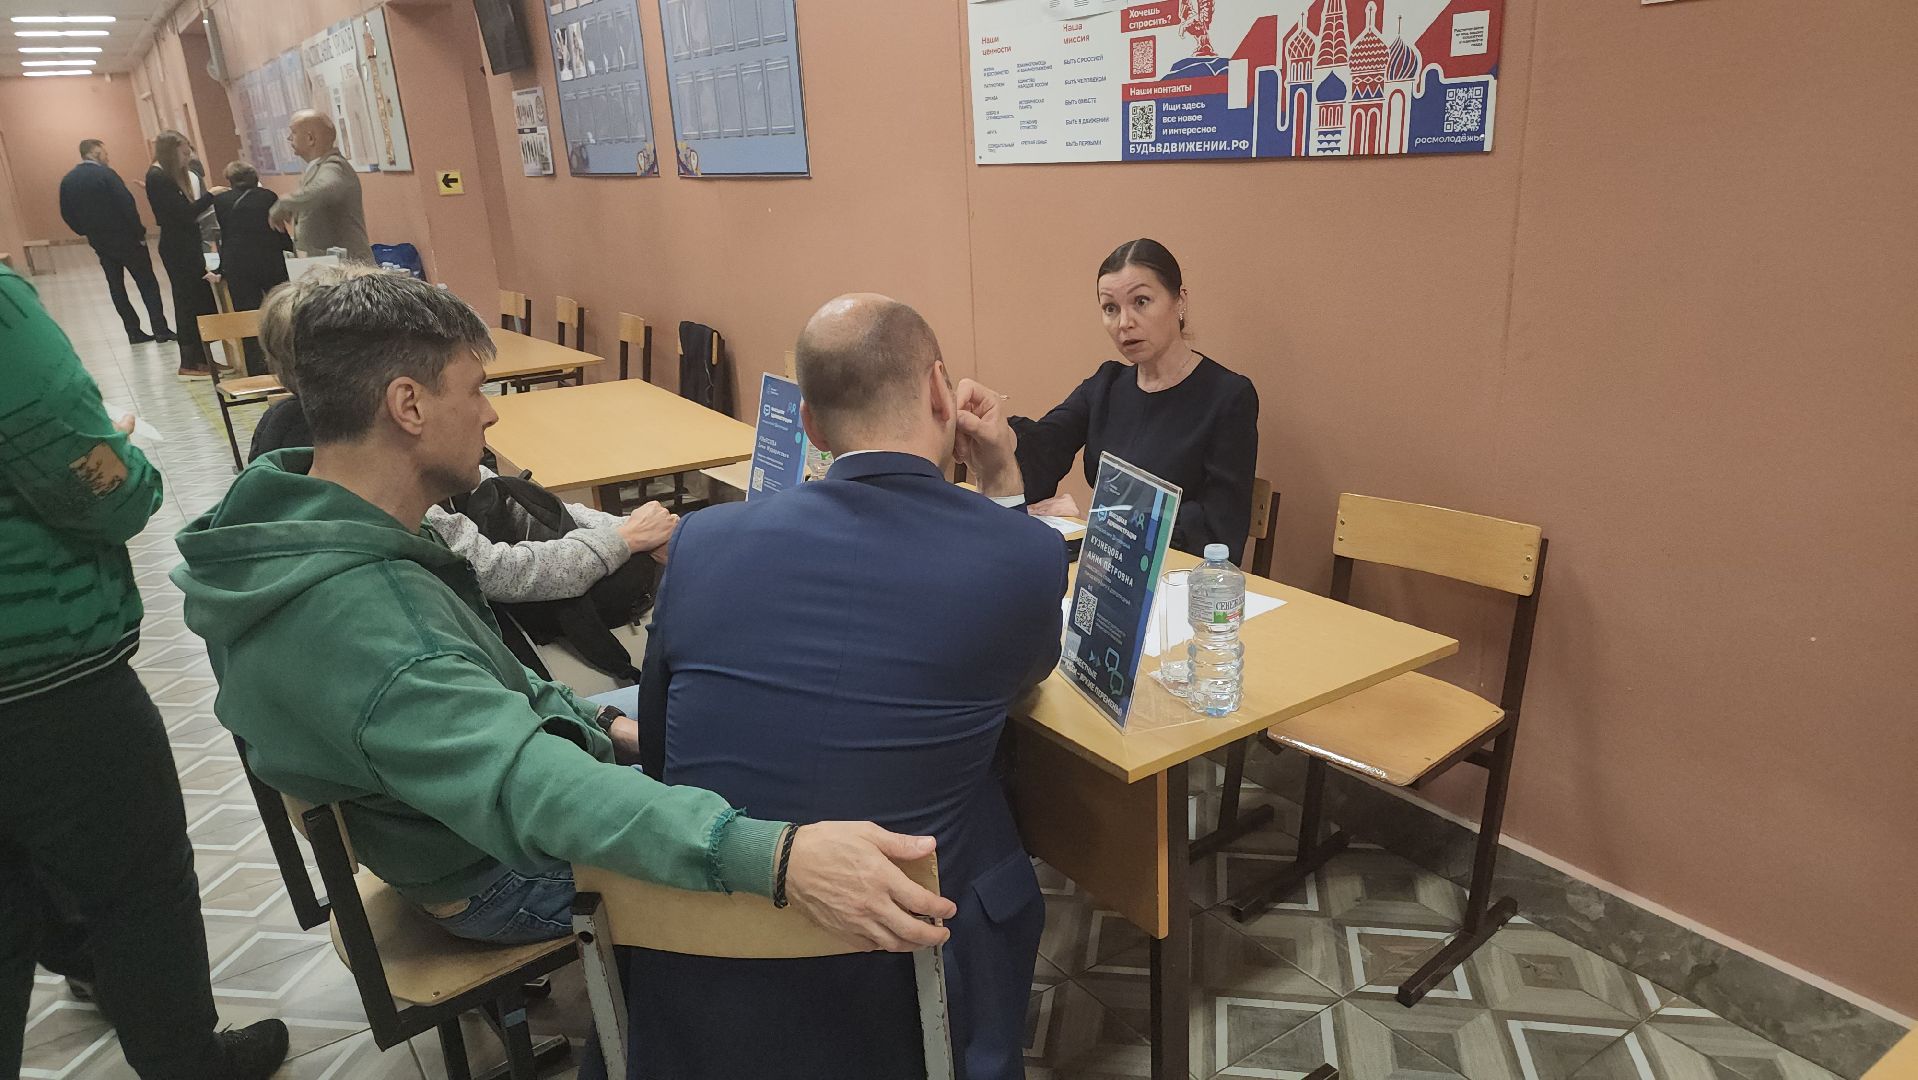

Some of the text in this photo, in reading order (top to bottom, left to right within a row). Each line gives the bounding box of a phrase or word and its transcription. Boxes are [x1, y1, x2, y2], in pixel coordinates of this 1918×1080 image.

[1129, 7, 1160, 18] Хочешь
[1129, 14, 1172, 29] спросить?
[1062, 24, 1083, 32] Наша
[981, 36, 1000, 45] Наши
[1063, 35, 1090, 45] миссия
[982, 46, 1012, 56] ценности
[1081, 54, 1104, 63] РОССИЕЙ
[1130, 84, 1192, 96] Наши контакты
[1162, 101, 1206, 112] Ищи здесь
[1178, 114, 1203, 122] новое
[1168, 126, 1217, 136] интересное
[1414, 133, 1482, 148] росмолодёжь
[1130, 139, 1250, 155] БУДЬВДВИЖЕНИИ.РФ
[1090, 535, 1123, 562] КУЗНЕЦОВА
[1086, 550, 1102, 565] АННА
[1104, 560, 1134, 587] ПЕТРОВНА
